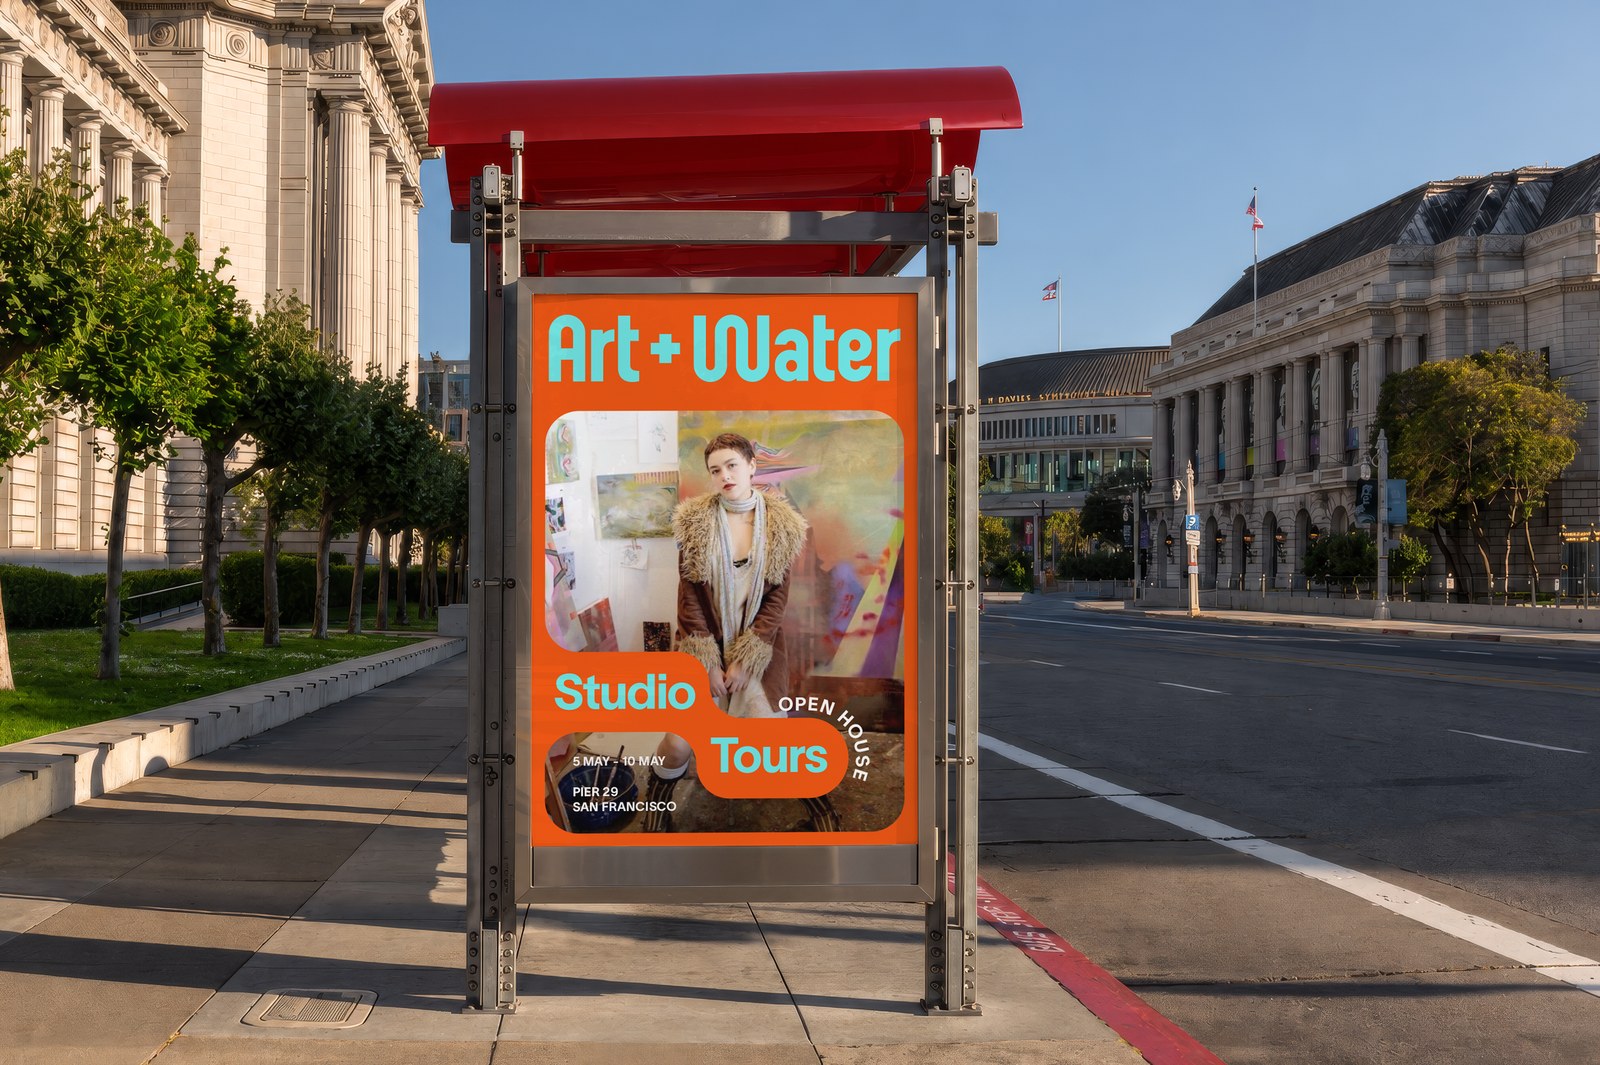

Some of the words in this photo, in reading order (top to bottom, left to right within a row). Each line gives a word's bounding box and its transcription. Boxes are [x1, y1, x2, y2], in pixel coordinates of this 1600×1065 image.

[548, 314, 640, 383] Art
[650, 333, 681, 364] +
[693, 314, 901, 383] Water
[998, 394, 1031, 404] DAVIES
[554, 673, 696, 711] Studio
[778, 696, 836, 716] OPEN
[837, 710, 871, 782] HOUSE
[573, 756, 581, 767] 5
[583, 756, 610, 767] MAY
[622, 755, 636, 767] 10
[638, 755, 666, 766] MAY
[710, 737, 828, 774] Tours
[573, 786, 599, 797] PIER
[602, 786, 619, 797] 29
[572, 801, 598, 812] SAN
[601, 801, 677, 812] FRANCISCO
